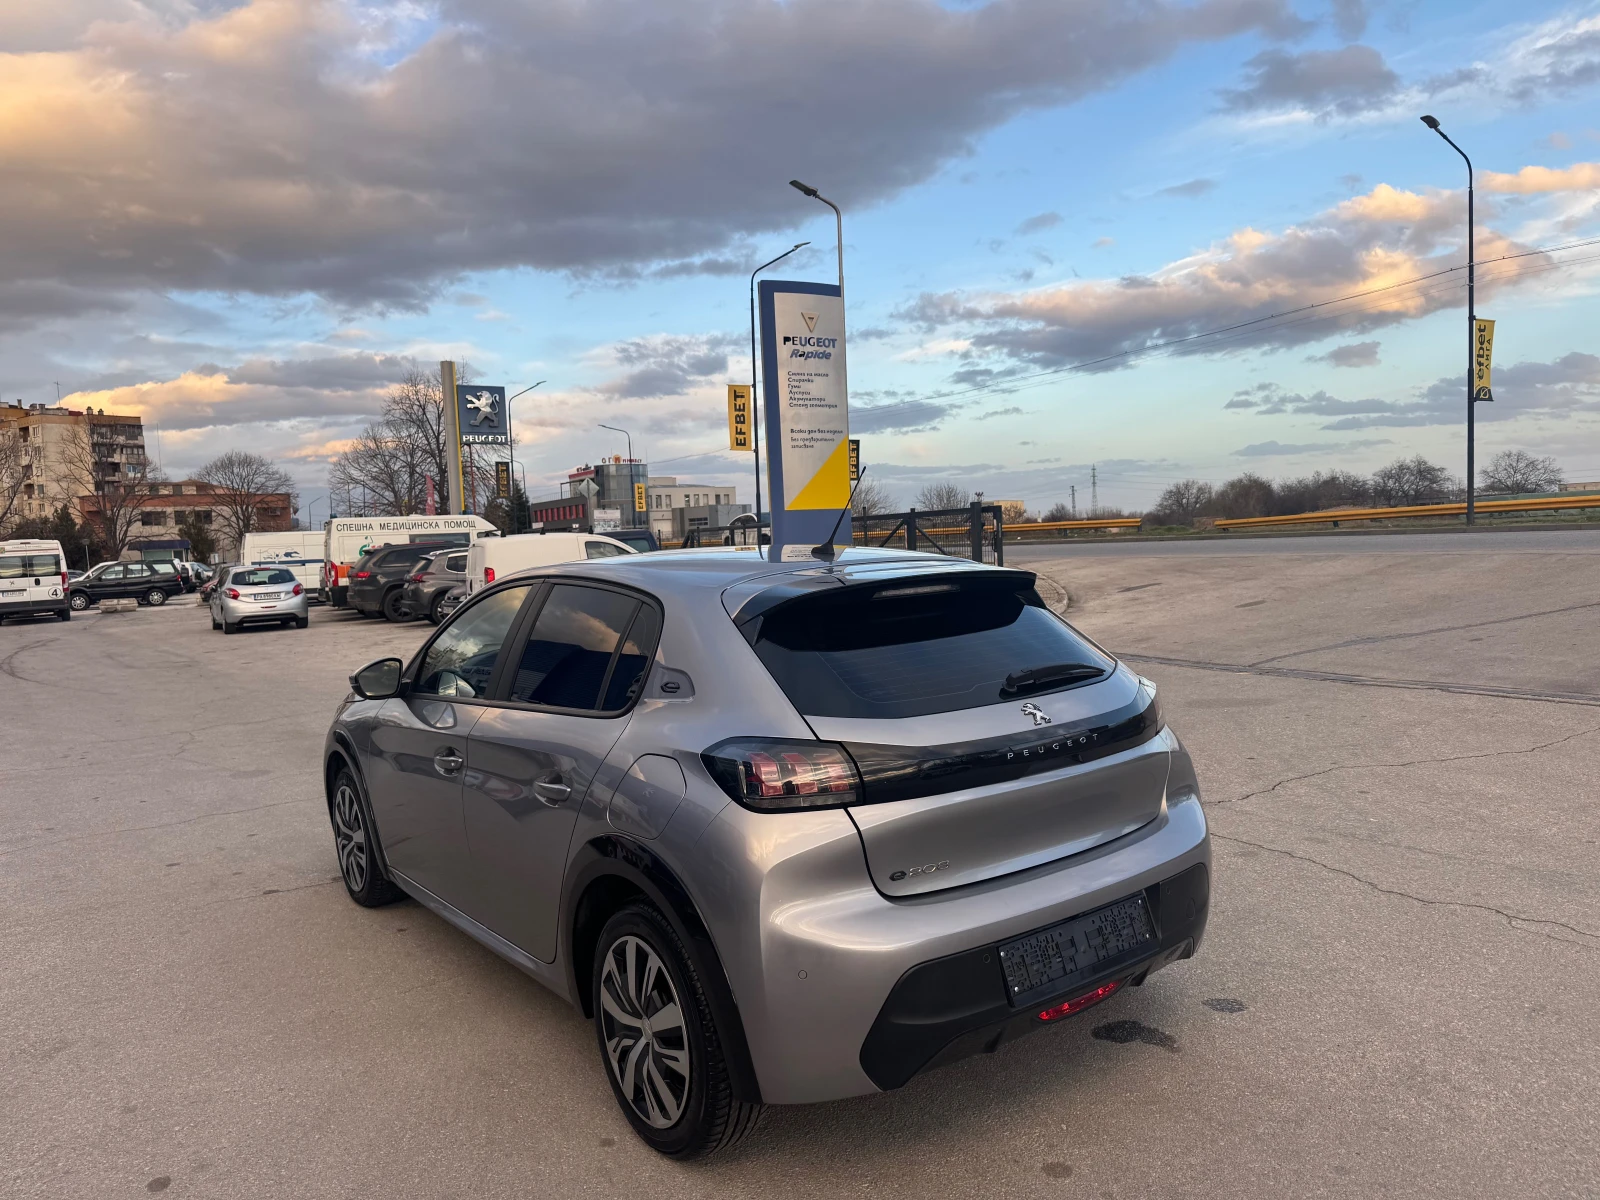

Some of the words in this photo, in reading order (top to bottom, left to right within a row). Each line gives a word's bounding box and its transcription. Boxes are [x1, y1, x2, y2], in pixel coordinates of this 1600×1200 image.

[783, 336, 837, 348] PEUGEOT
[790, 348, 832, 360] Rapide
[1477, 324, 1487, 381] efbet
[734, 389, 746, 447] EFBET
[462, 434, 506, 443] PEUGEOT
[336, 523, 374, 532] СПЕШНА
[379, 521, 440, 531] МЕДИЦИНСКА
[443, 520, 477, 529] ПОМОЩ
[51, 588, 59, 597] 4
[1007, 733, 1099, 760] PEUGEOT
